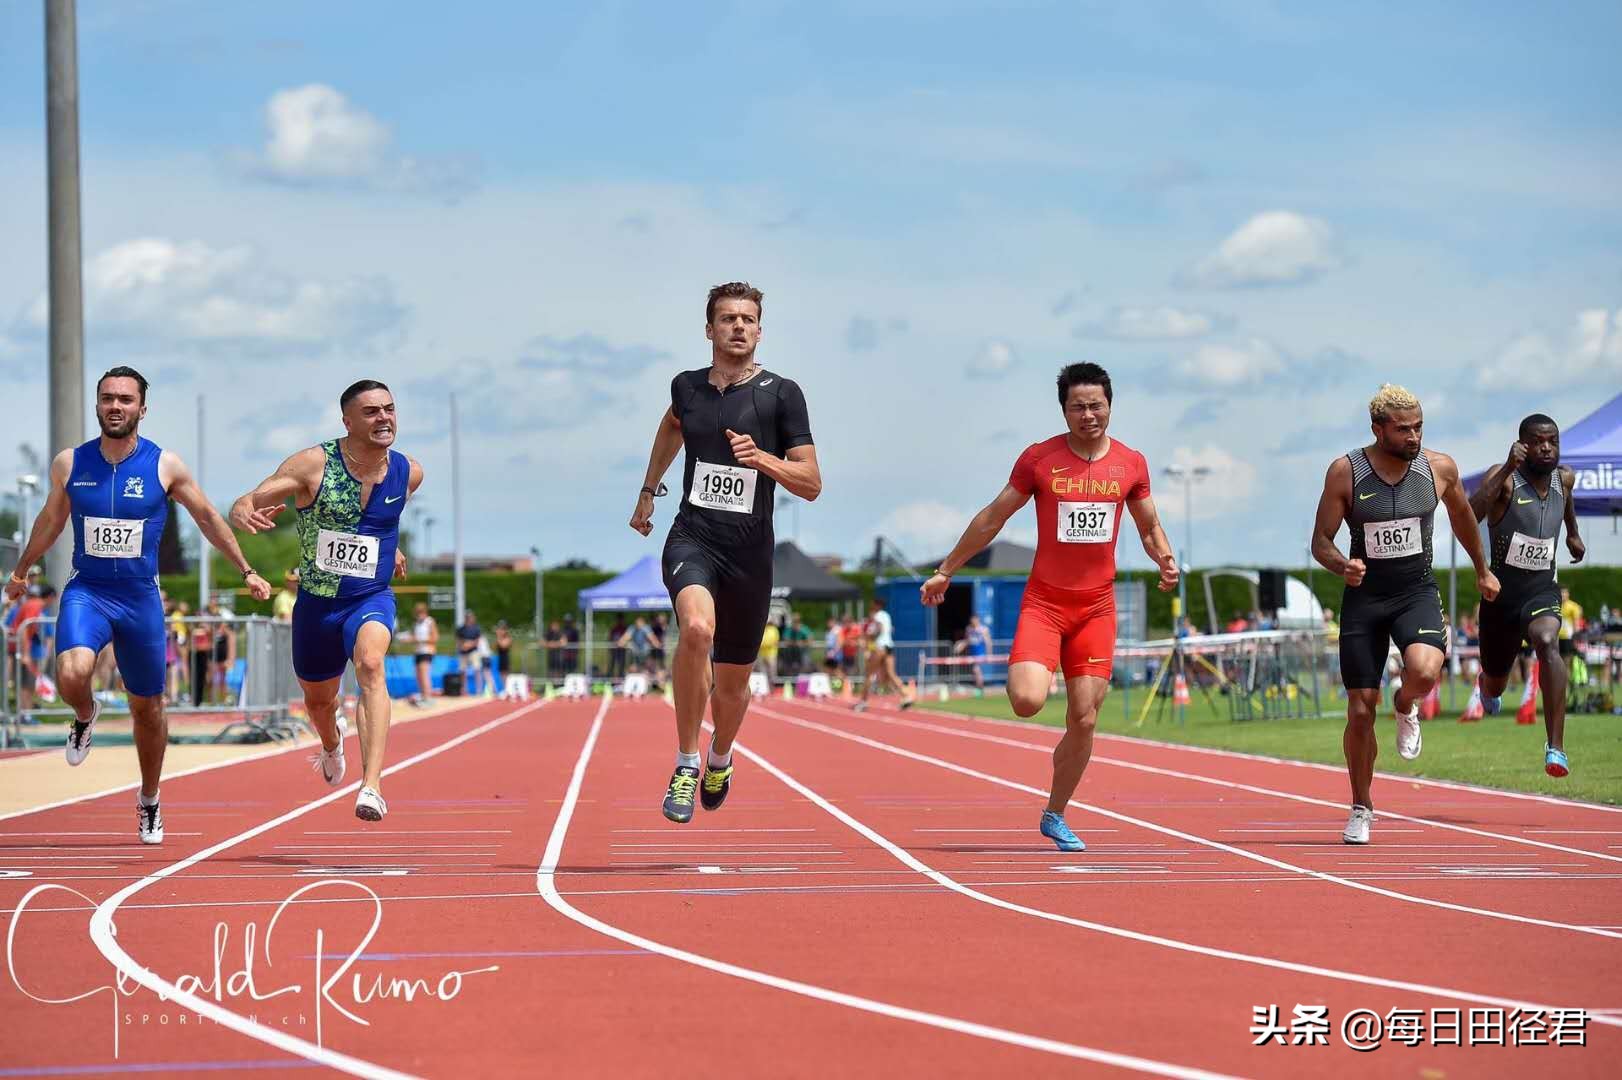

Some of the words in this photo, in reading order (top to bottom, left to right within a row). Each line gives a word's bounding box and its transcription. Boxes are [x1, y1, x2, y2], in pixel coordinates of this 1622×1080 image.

[703, 474, 744, 496] 1990
[1052, 477, 1121, 497] CHINA
[699, 493, 733, 504] GESTINA
[1068, 511, 1107, 529] 1937
[93, 527, 133, 544] 1837
[1066, 529, 1099, 537] GESTINA
[1373, 527, 1411, 546] 1867
[92, 544, 124, 552] GESTINA
[327, 541, 369, 563] 1878
[1373, 545, 1406, 554] GESTINA
[1519, 543, 1549, 560] 1822
[324, 558, 358, 570] GESTINA
